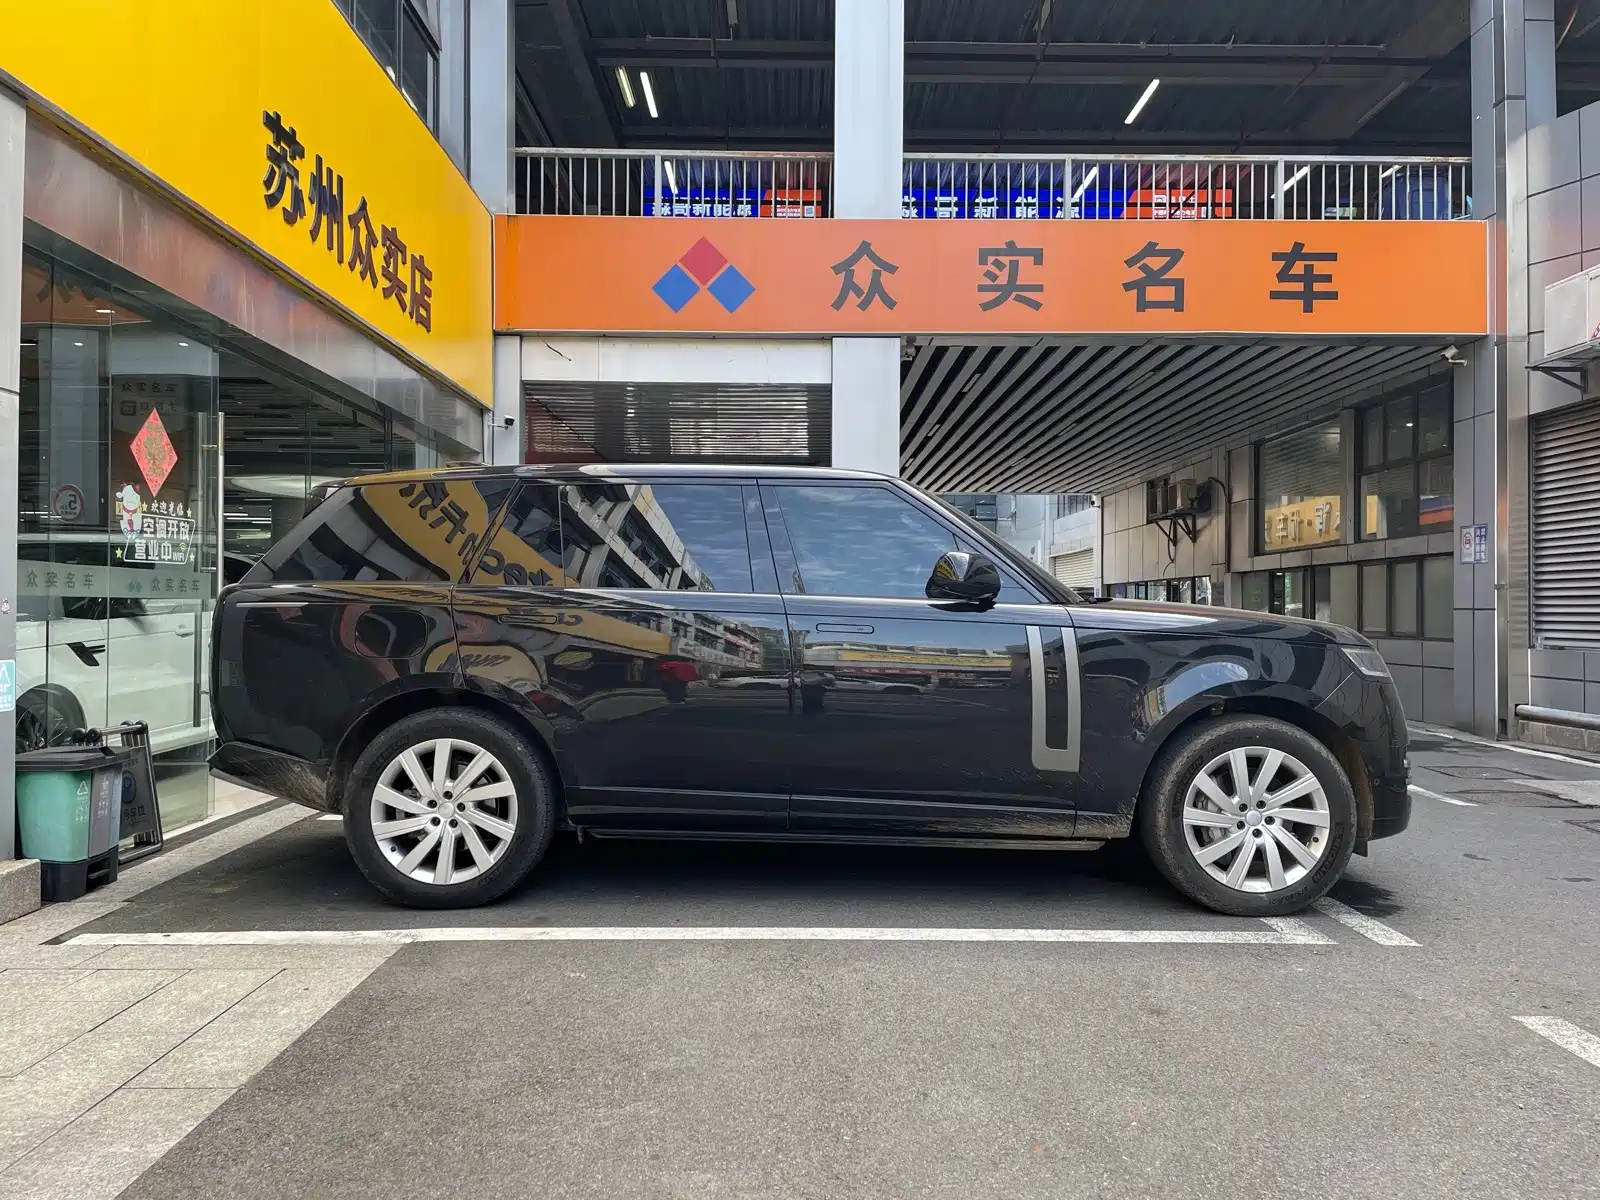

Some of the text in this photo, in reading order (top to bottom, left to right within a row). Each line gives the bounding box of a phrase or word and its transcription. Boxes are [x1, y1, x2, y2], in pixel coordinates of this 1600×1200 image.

[262, 109, 433, 333] 苏州众实店
[830, 239, 1339, 314] 众实名车
[150, 499, 184, 517] 欢迎光临
[143, 517, 190, 541] 空调开放
[134, 538, 172, 561] 营业中
[25, 569, 95, 589] 众实名车
[151, 576, 201, 594] 众实名车
